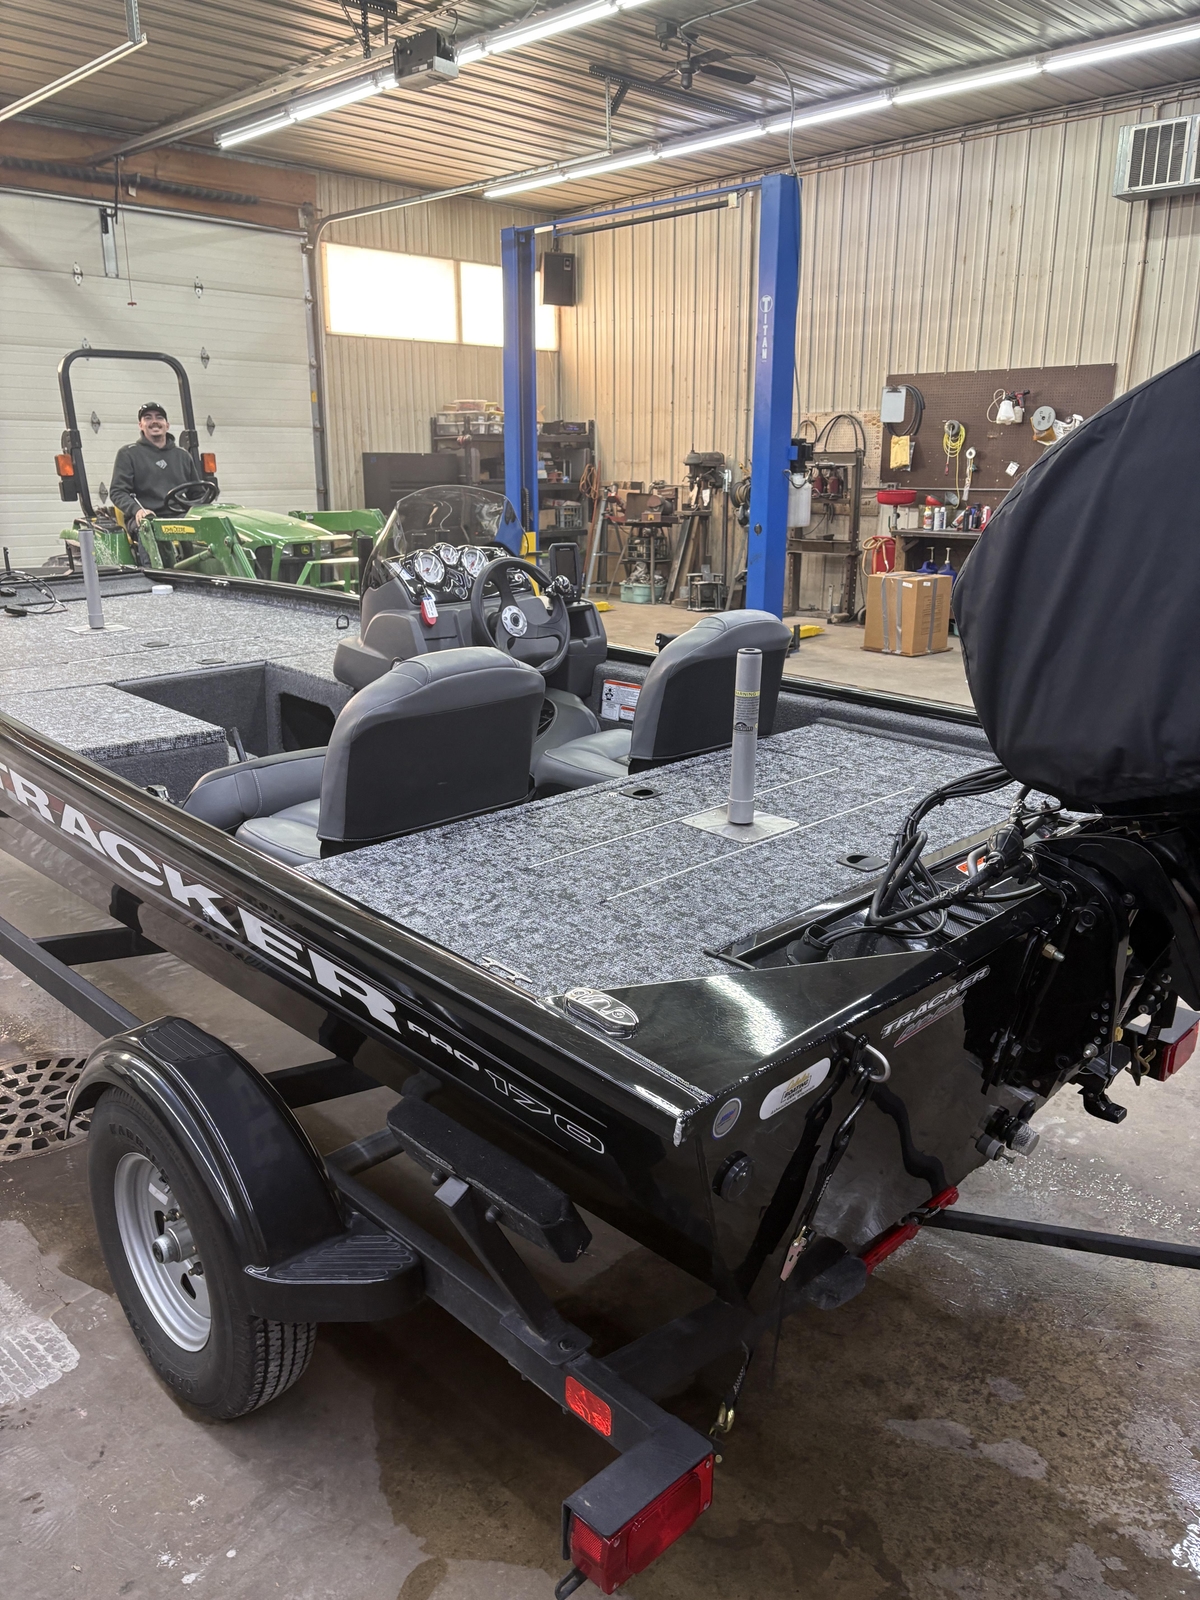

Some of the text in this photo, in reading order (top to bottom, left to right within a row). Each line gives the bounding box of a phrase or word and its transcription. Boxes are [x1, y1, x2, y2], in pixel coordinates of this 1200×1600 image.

[760, 295, 773, 359] TITAN
[881, 965, 990, 1039] TRACKER
[407, 1020, 480, 1071] PRO
[485, 1068, 605, 1154] 176
